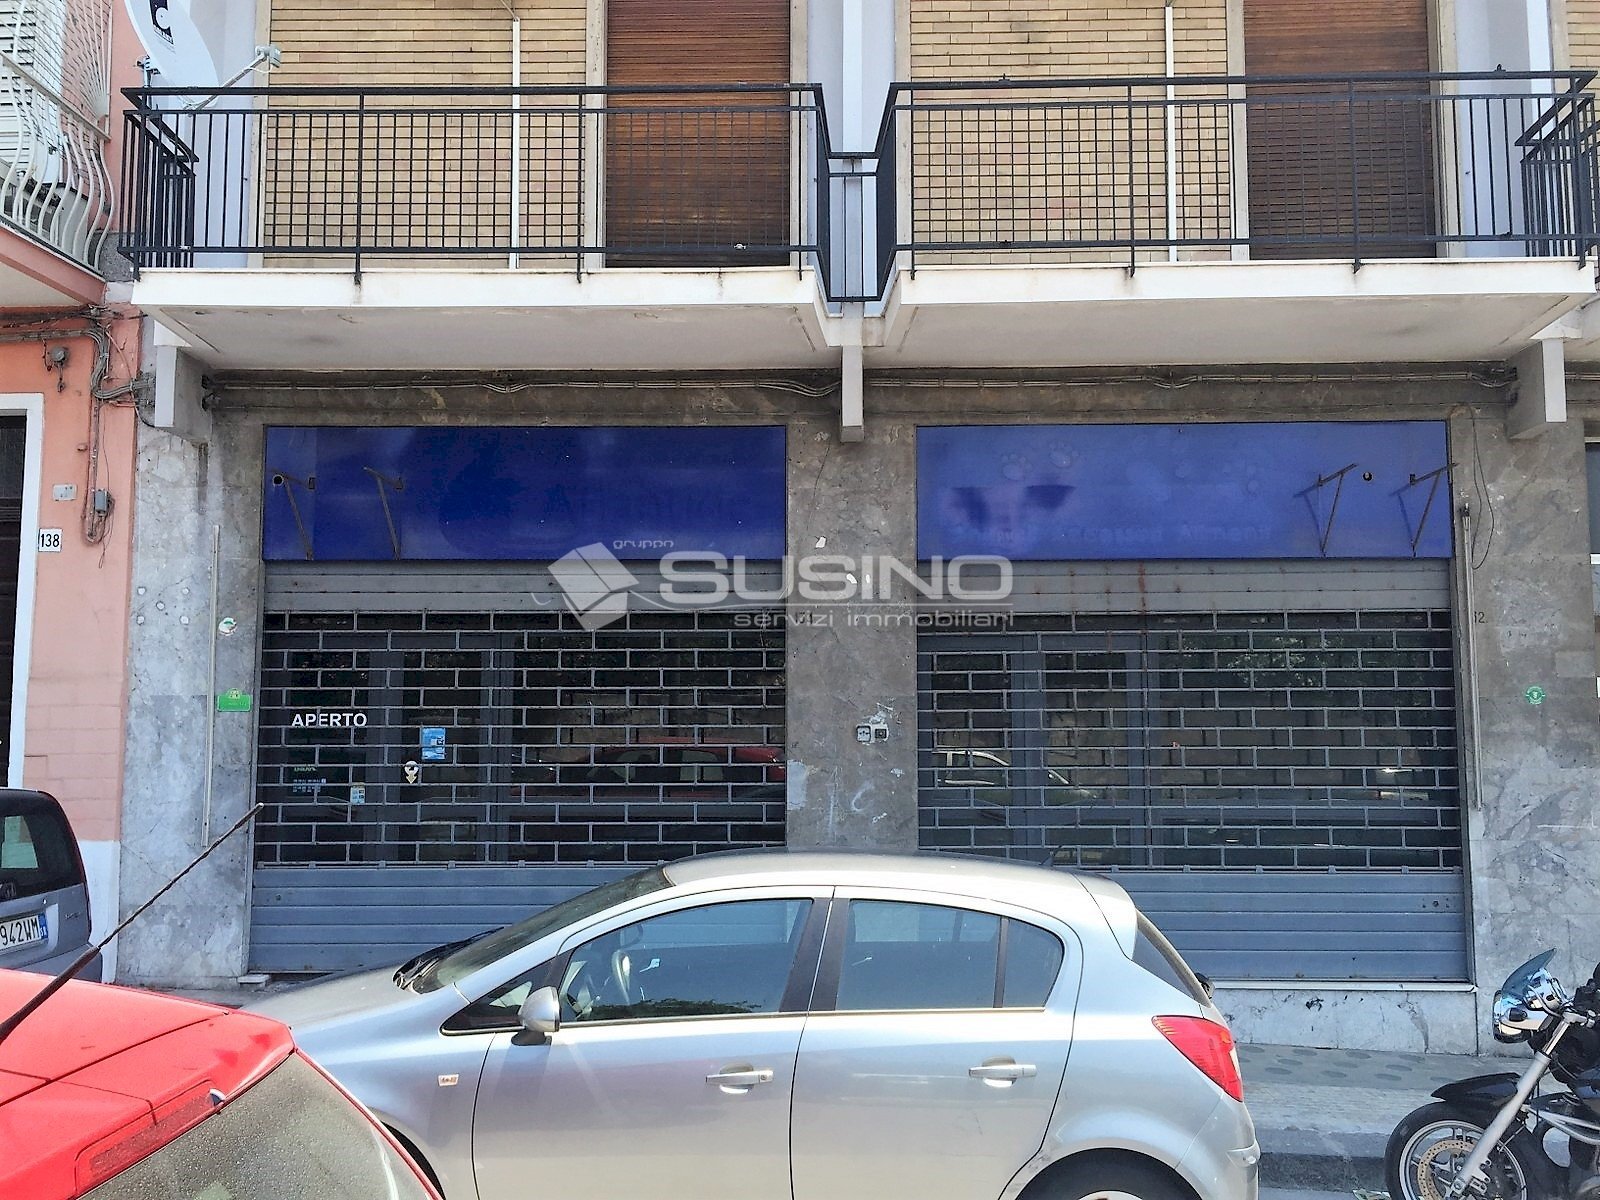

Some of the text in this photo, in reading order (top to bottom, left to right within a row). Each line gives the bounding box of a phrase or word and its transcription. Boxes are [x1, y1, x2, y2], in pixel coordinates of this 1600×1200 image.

[41, 533, 60, 548] 138
[291, 712, 368, 727] APERTO
[0, 917, 40, 946] 942WM
